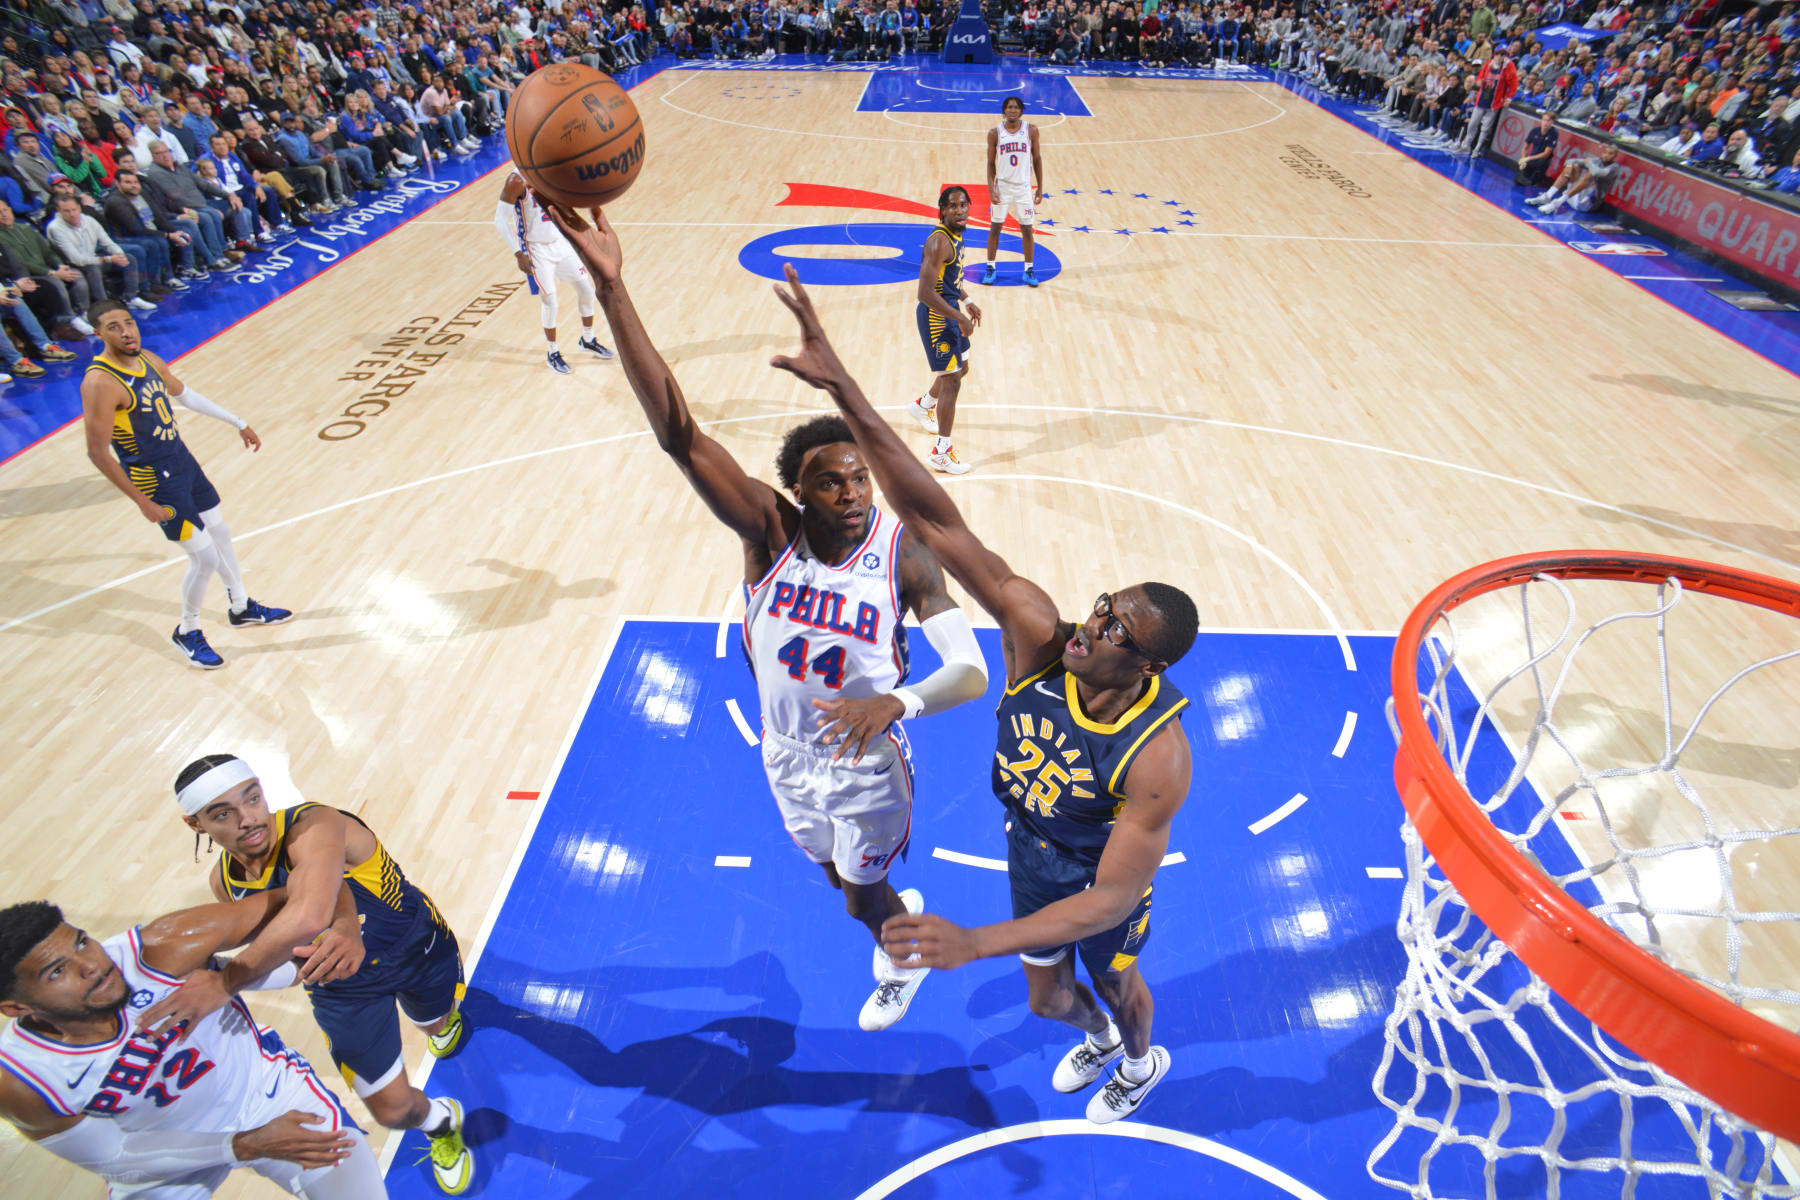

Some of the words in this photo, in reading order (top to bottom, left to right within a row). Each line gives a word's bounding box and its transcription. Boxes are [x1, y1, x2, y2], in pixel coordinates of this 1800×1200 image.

[574, 132, 646, 181] Wilson
[1000, 142, 1027, 155] PHILA
[1009, 154, 1018, 167] 0
[1284, 144, 1331, 168] WELLS
[1317, 169, 1372, 198] FARGO
[310, 177, 460, 241] Brotherly
[1611, 165, 1694, 220] RAV4th
[1697, 202, 1800, 278] QUAR
[233, 238, 339, 284] Love
[423, 279, 527, 346] WELLS
[337, 316, 440, 382] CENTER
[154, 396, 172, 425] 0
[317, 351, 449, 441] FARGO
[768, 581, 880, 645] PHILA
[777, 636, 846, 690] 44
[995, 751, 1064, 818] PACER
[1008, 738, 1072, 807] 25
[1010, 713, 1096, 799] INDIANA
[83, 1019, 189, 1115] PHIL
[143, 1047, 216, 1108] 12
